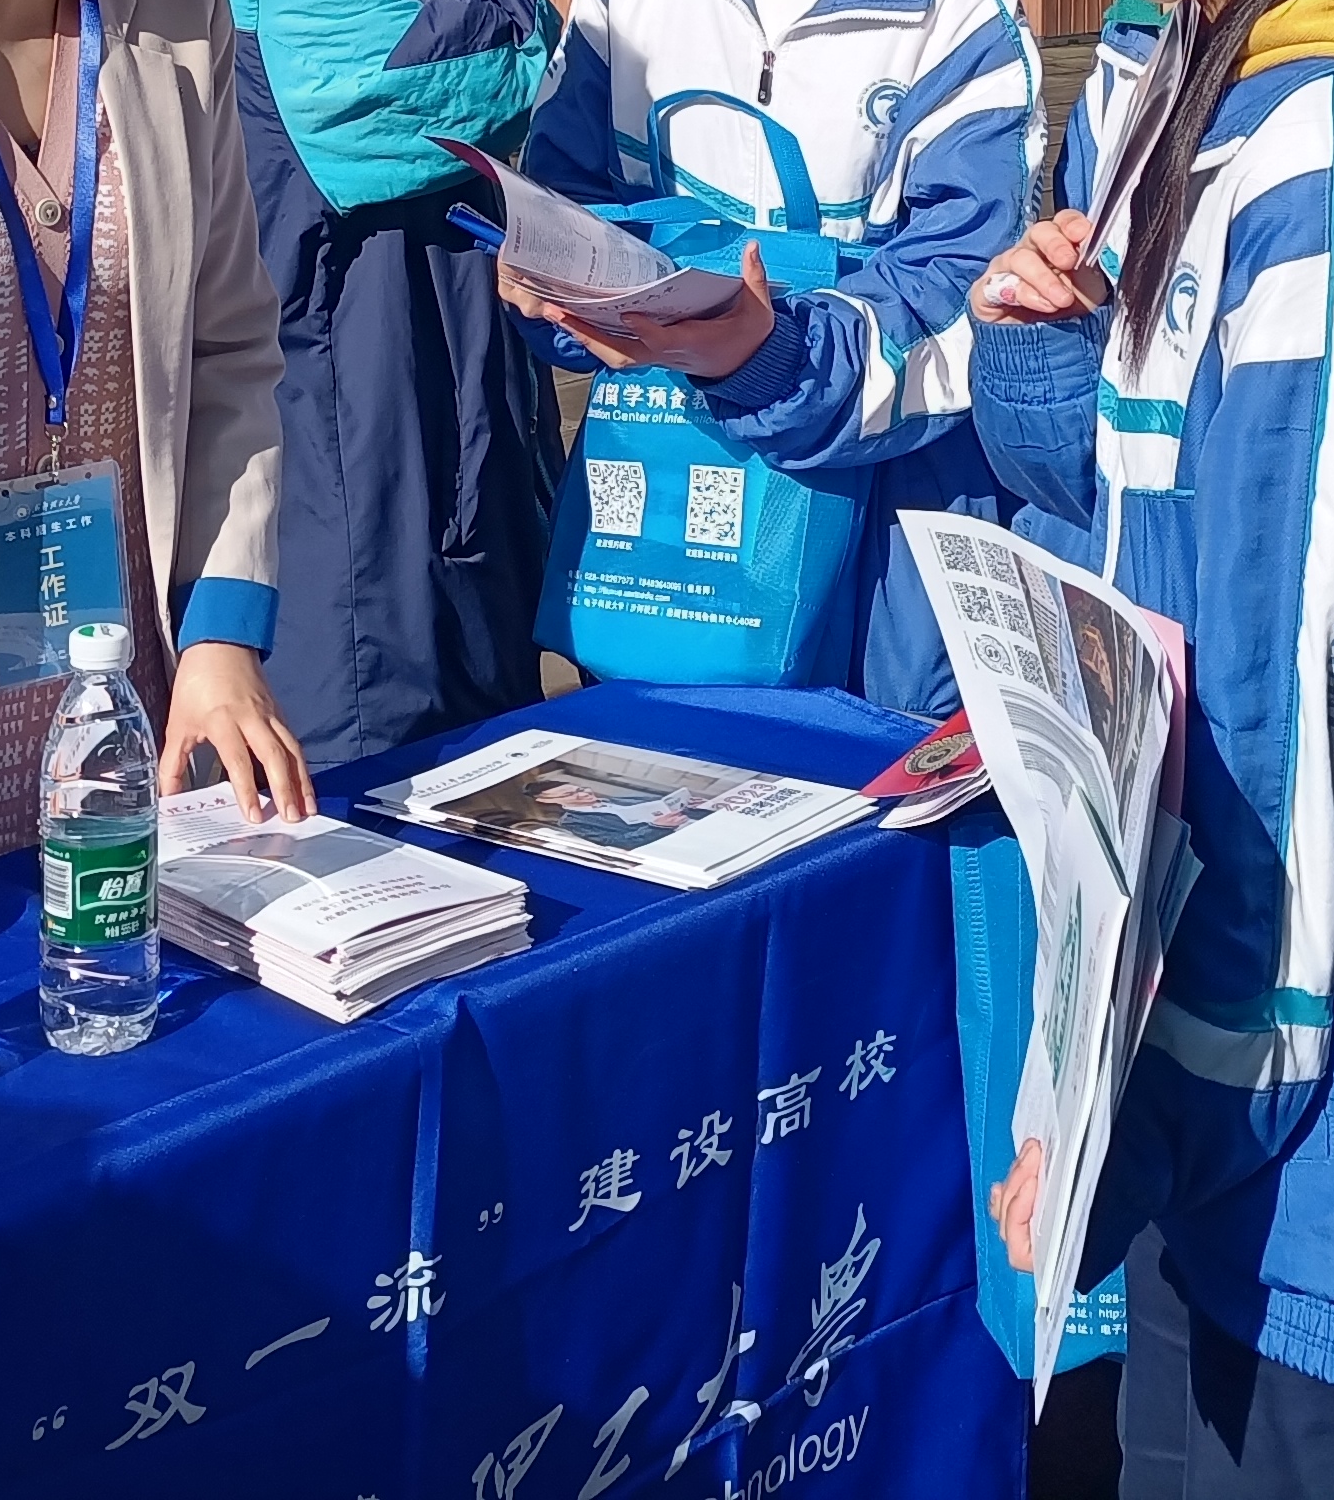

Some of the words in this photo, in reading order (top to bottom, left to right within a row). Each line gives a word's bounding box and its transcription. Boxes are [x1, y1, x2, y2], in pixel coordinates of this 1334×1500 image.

[39, 545, 69, 628] 工作证
[711, 783, 758, 812] 2023
